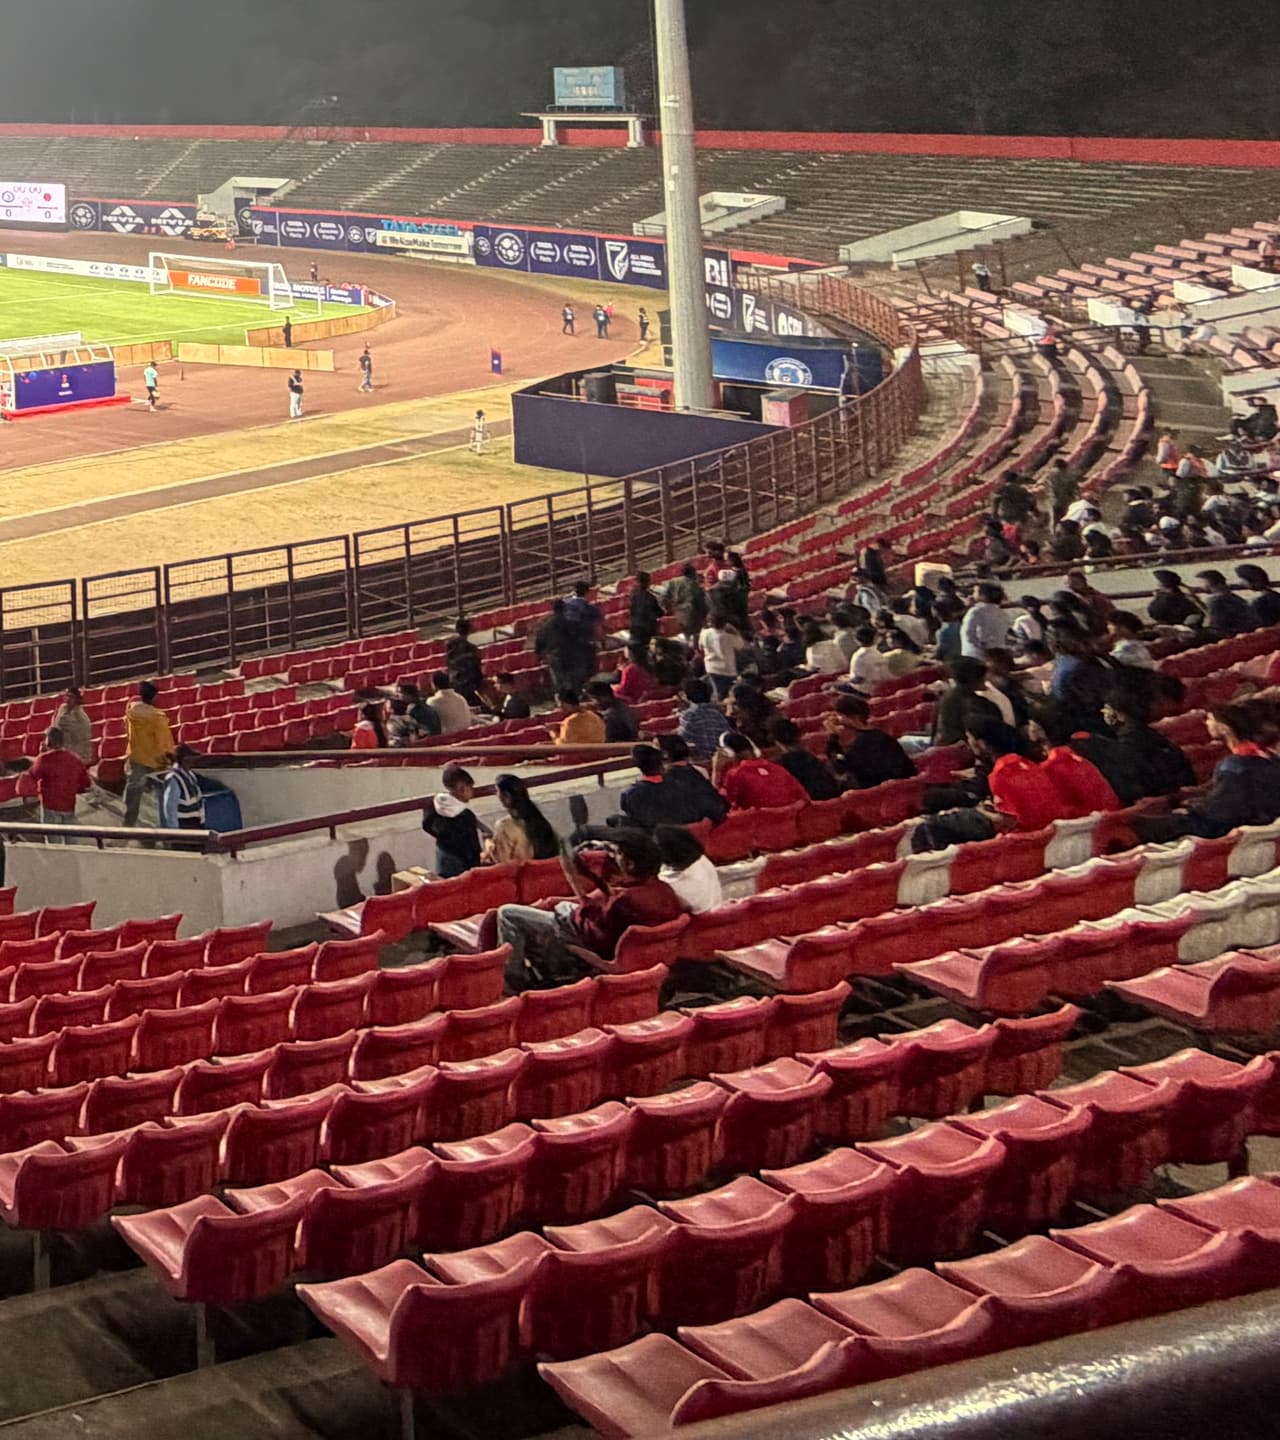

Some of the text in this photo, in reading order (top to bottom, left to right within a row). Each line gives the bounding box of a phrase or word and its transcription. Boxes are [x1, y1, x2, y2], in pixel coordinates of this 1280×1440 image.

[102, 215, 145, 224] NIVIA
[151, 218, 194, 226] NIVIA
[381, 219, 418, 232] TATA
[704, 257, 729, 288] BI
[188, 274, 237, 289] FANCODE
